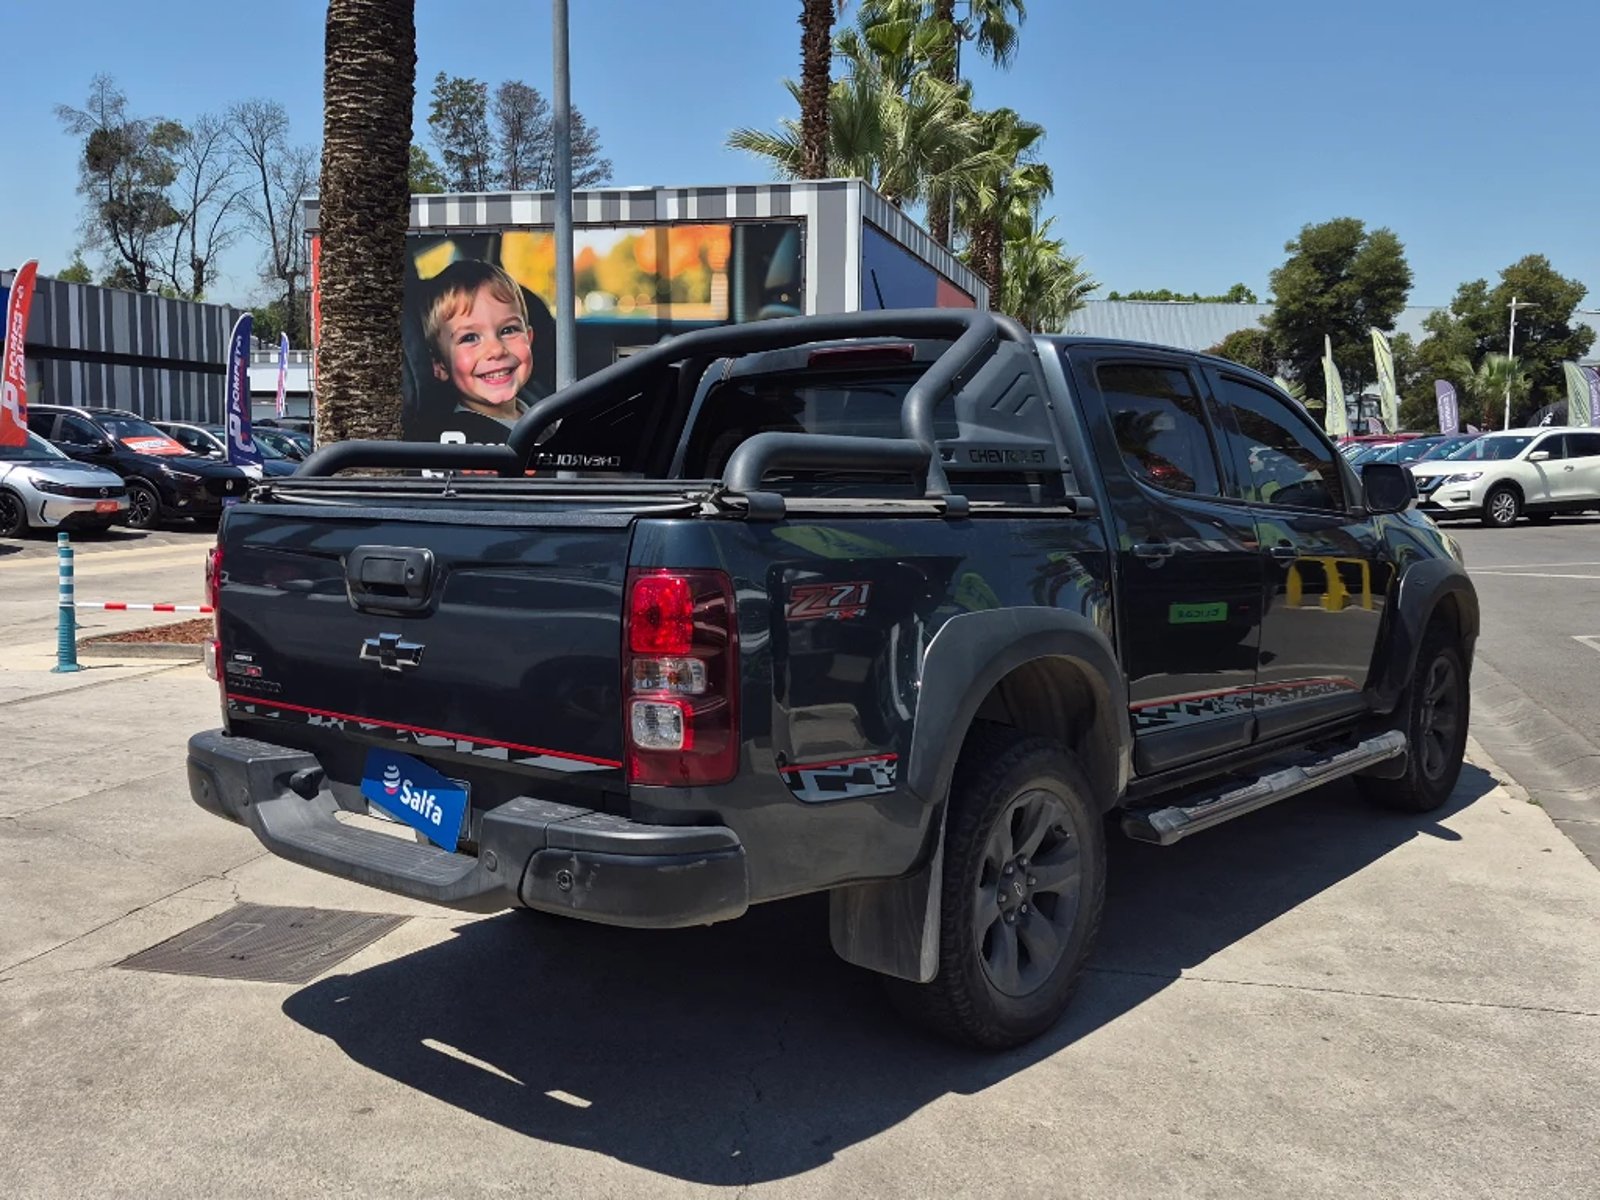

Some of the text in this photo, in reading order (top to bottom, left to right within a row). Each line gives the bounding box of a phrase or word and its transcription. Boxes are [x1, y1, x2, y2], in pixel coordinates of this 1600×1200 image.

[969, 449, 1046, 464] CHEVROLET
[785, 582, 871, 620] Z71
[400, 779, 443, 826] Salfa
